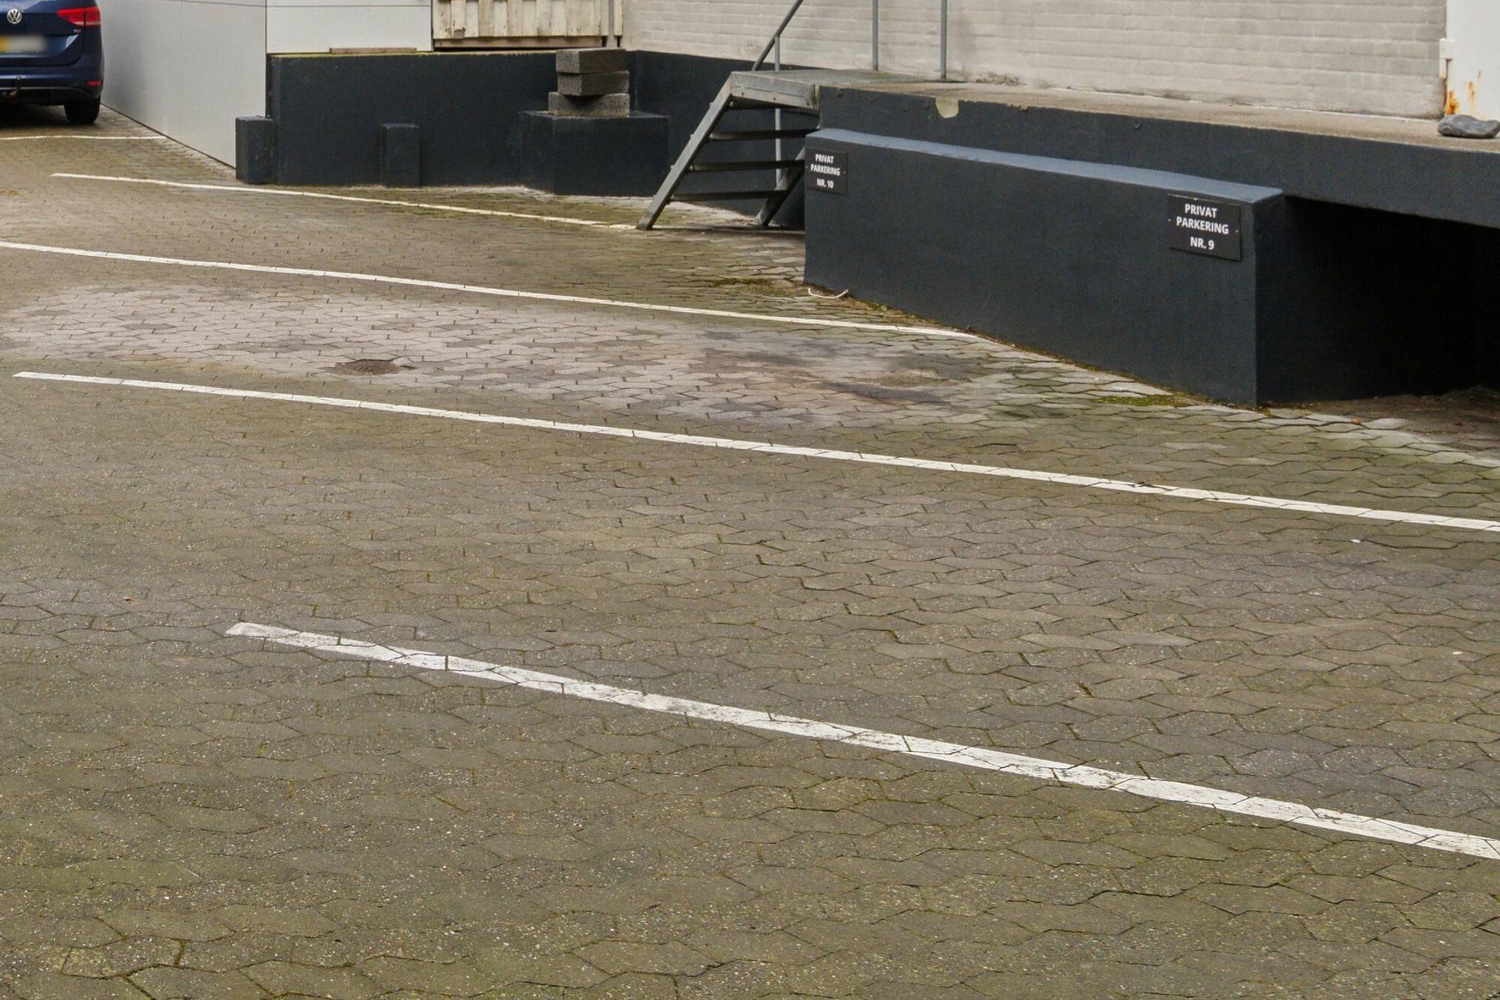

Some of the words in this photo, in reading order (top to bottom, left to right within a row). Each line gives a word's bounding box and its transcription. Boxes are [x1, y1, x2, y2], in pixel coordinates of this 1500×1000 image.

[815, 153, 834, 164] PRIVAT
[810, 163, 840, 176] PARKERING
[816, 178, 826, 188] NR.
[827, 180, 834, 189] 10
[1184, 203, 1218, 218] PRIVAT
[1176, 216, 1229, 235] PARKERING
[1190, 236, 1207, 249] NR.
[1208, 239, 1215, 250] 9
